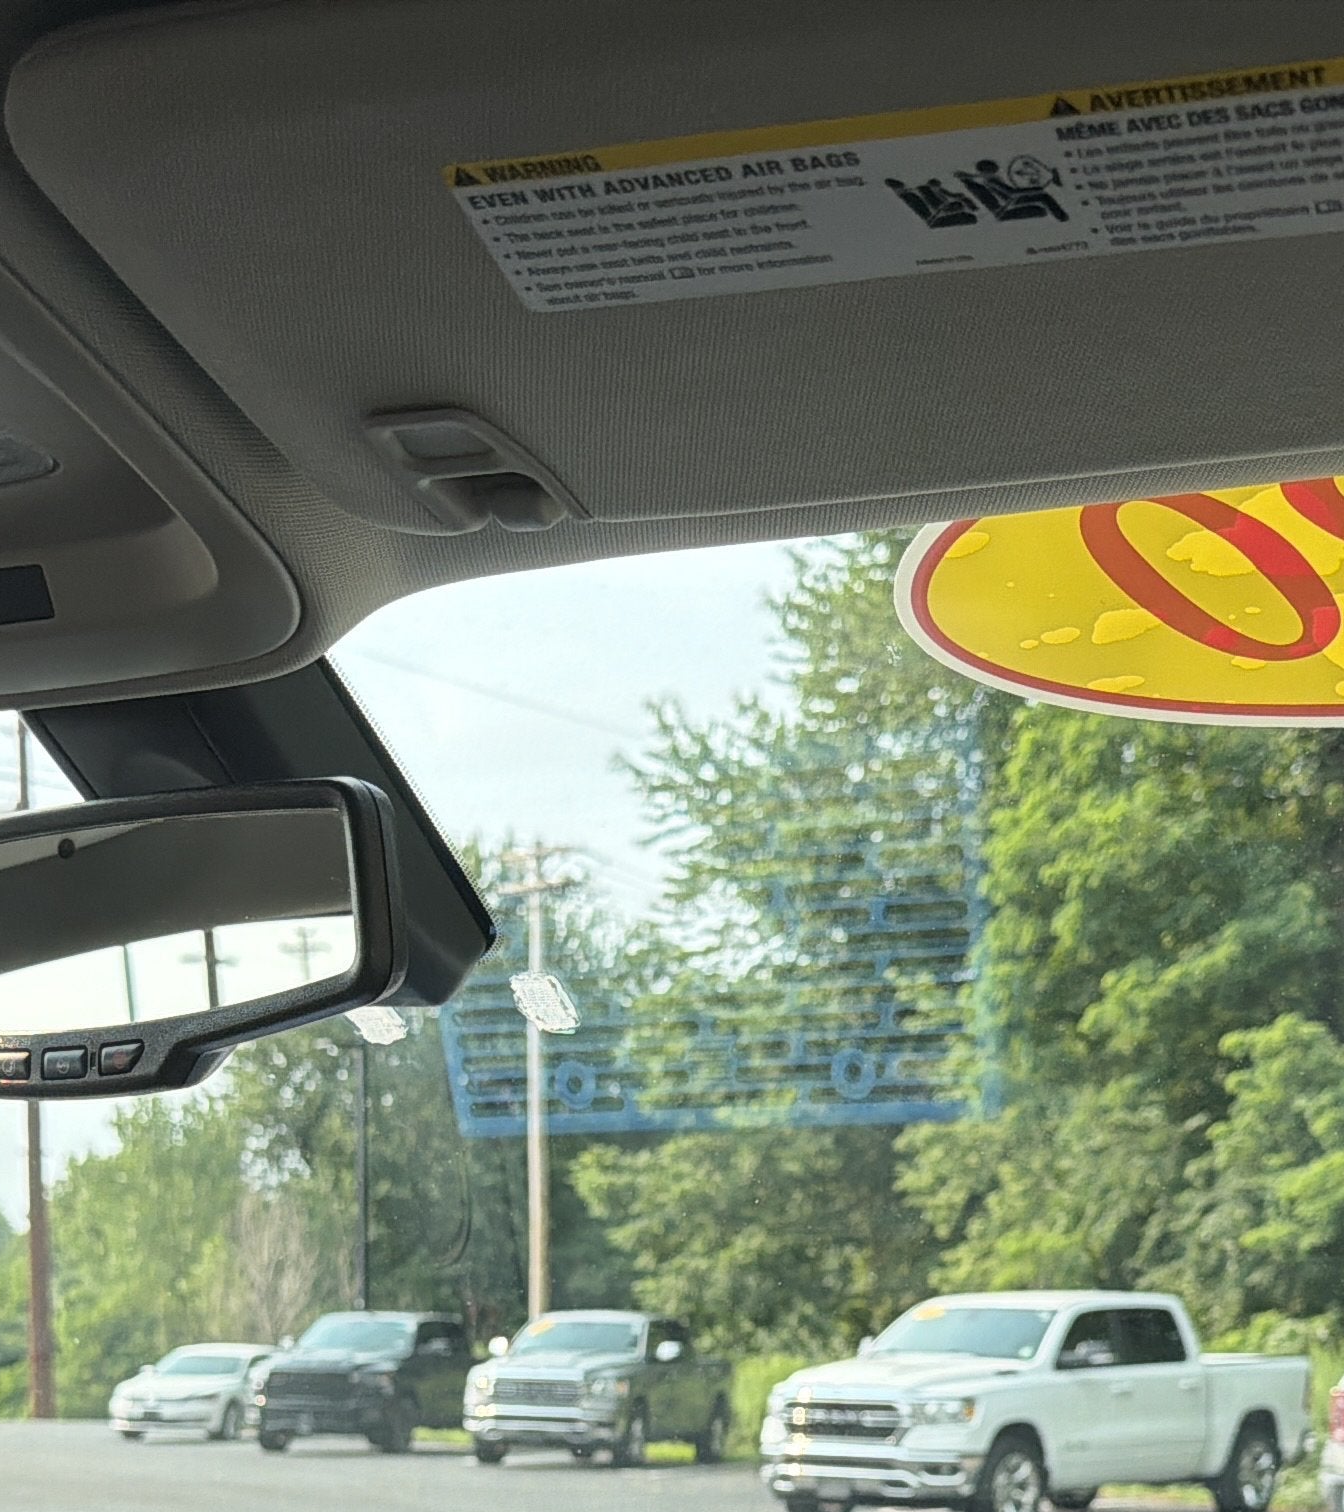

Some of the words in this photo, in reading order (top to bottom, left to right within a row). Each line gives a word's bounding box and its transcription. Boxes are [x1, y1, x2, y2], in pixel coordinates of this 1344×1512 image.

[1090, 63, 1327, 113] AVERTISSEMENT
[1126, 113, 1182, 132] AVEC
[1187, 108, 1230, 126] DES
[1235, 100, 1294, 120] SACS
[468, 190, 529, 210] EVEN
[534, 182, 595, 203] WITH
[604, 167, 733, 197] ADVANCED
[741, 159, 785, 180] AIR
[792, 151, 861, 173] BAGS
[482, 154, 602, 184] WARNING
